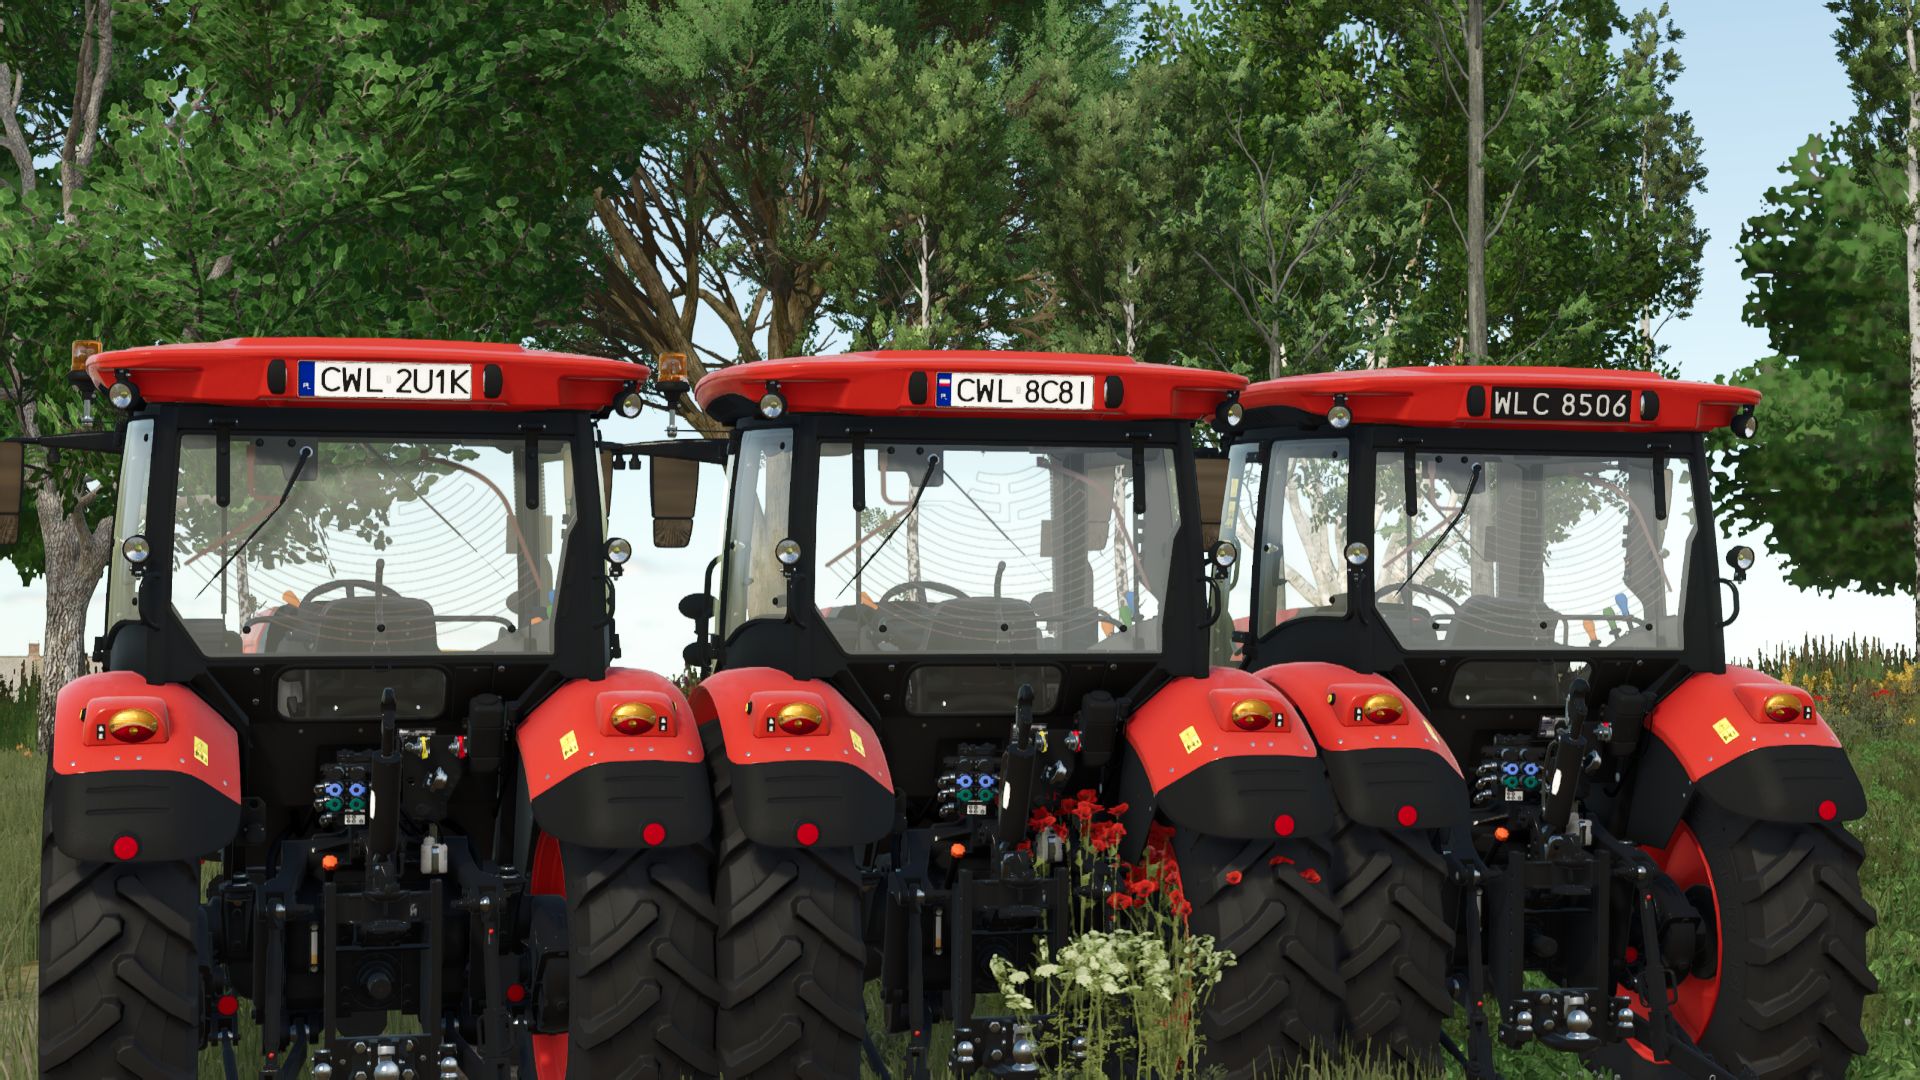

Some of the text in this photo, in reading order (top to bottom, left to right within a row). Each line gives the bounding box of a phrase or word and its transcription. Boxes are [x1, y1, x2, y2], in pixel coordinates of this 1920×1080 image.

[321, 366, 469, 394] CWL 2U1K
[957, 378, 1013, 402] CWL
[1494, 391, 1627, 417] WLC 8506
